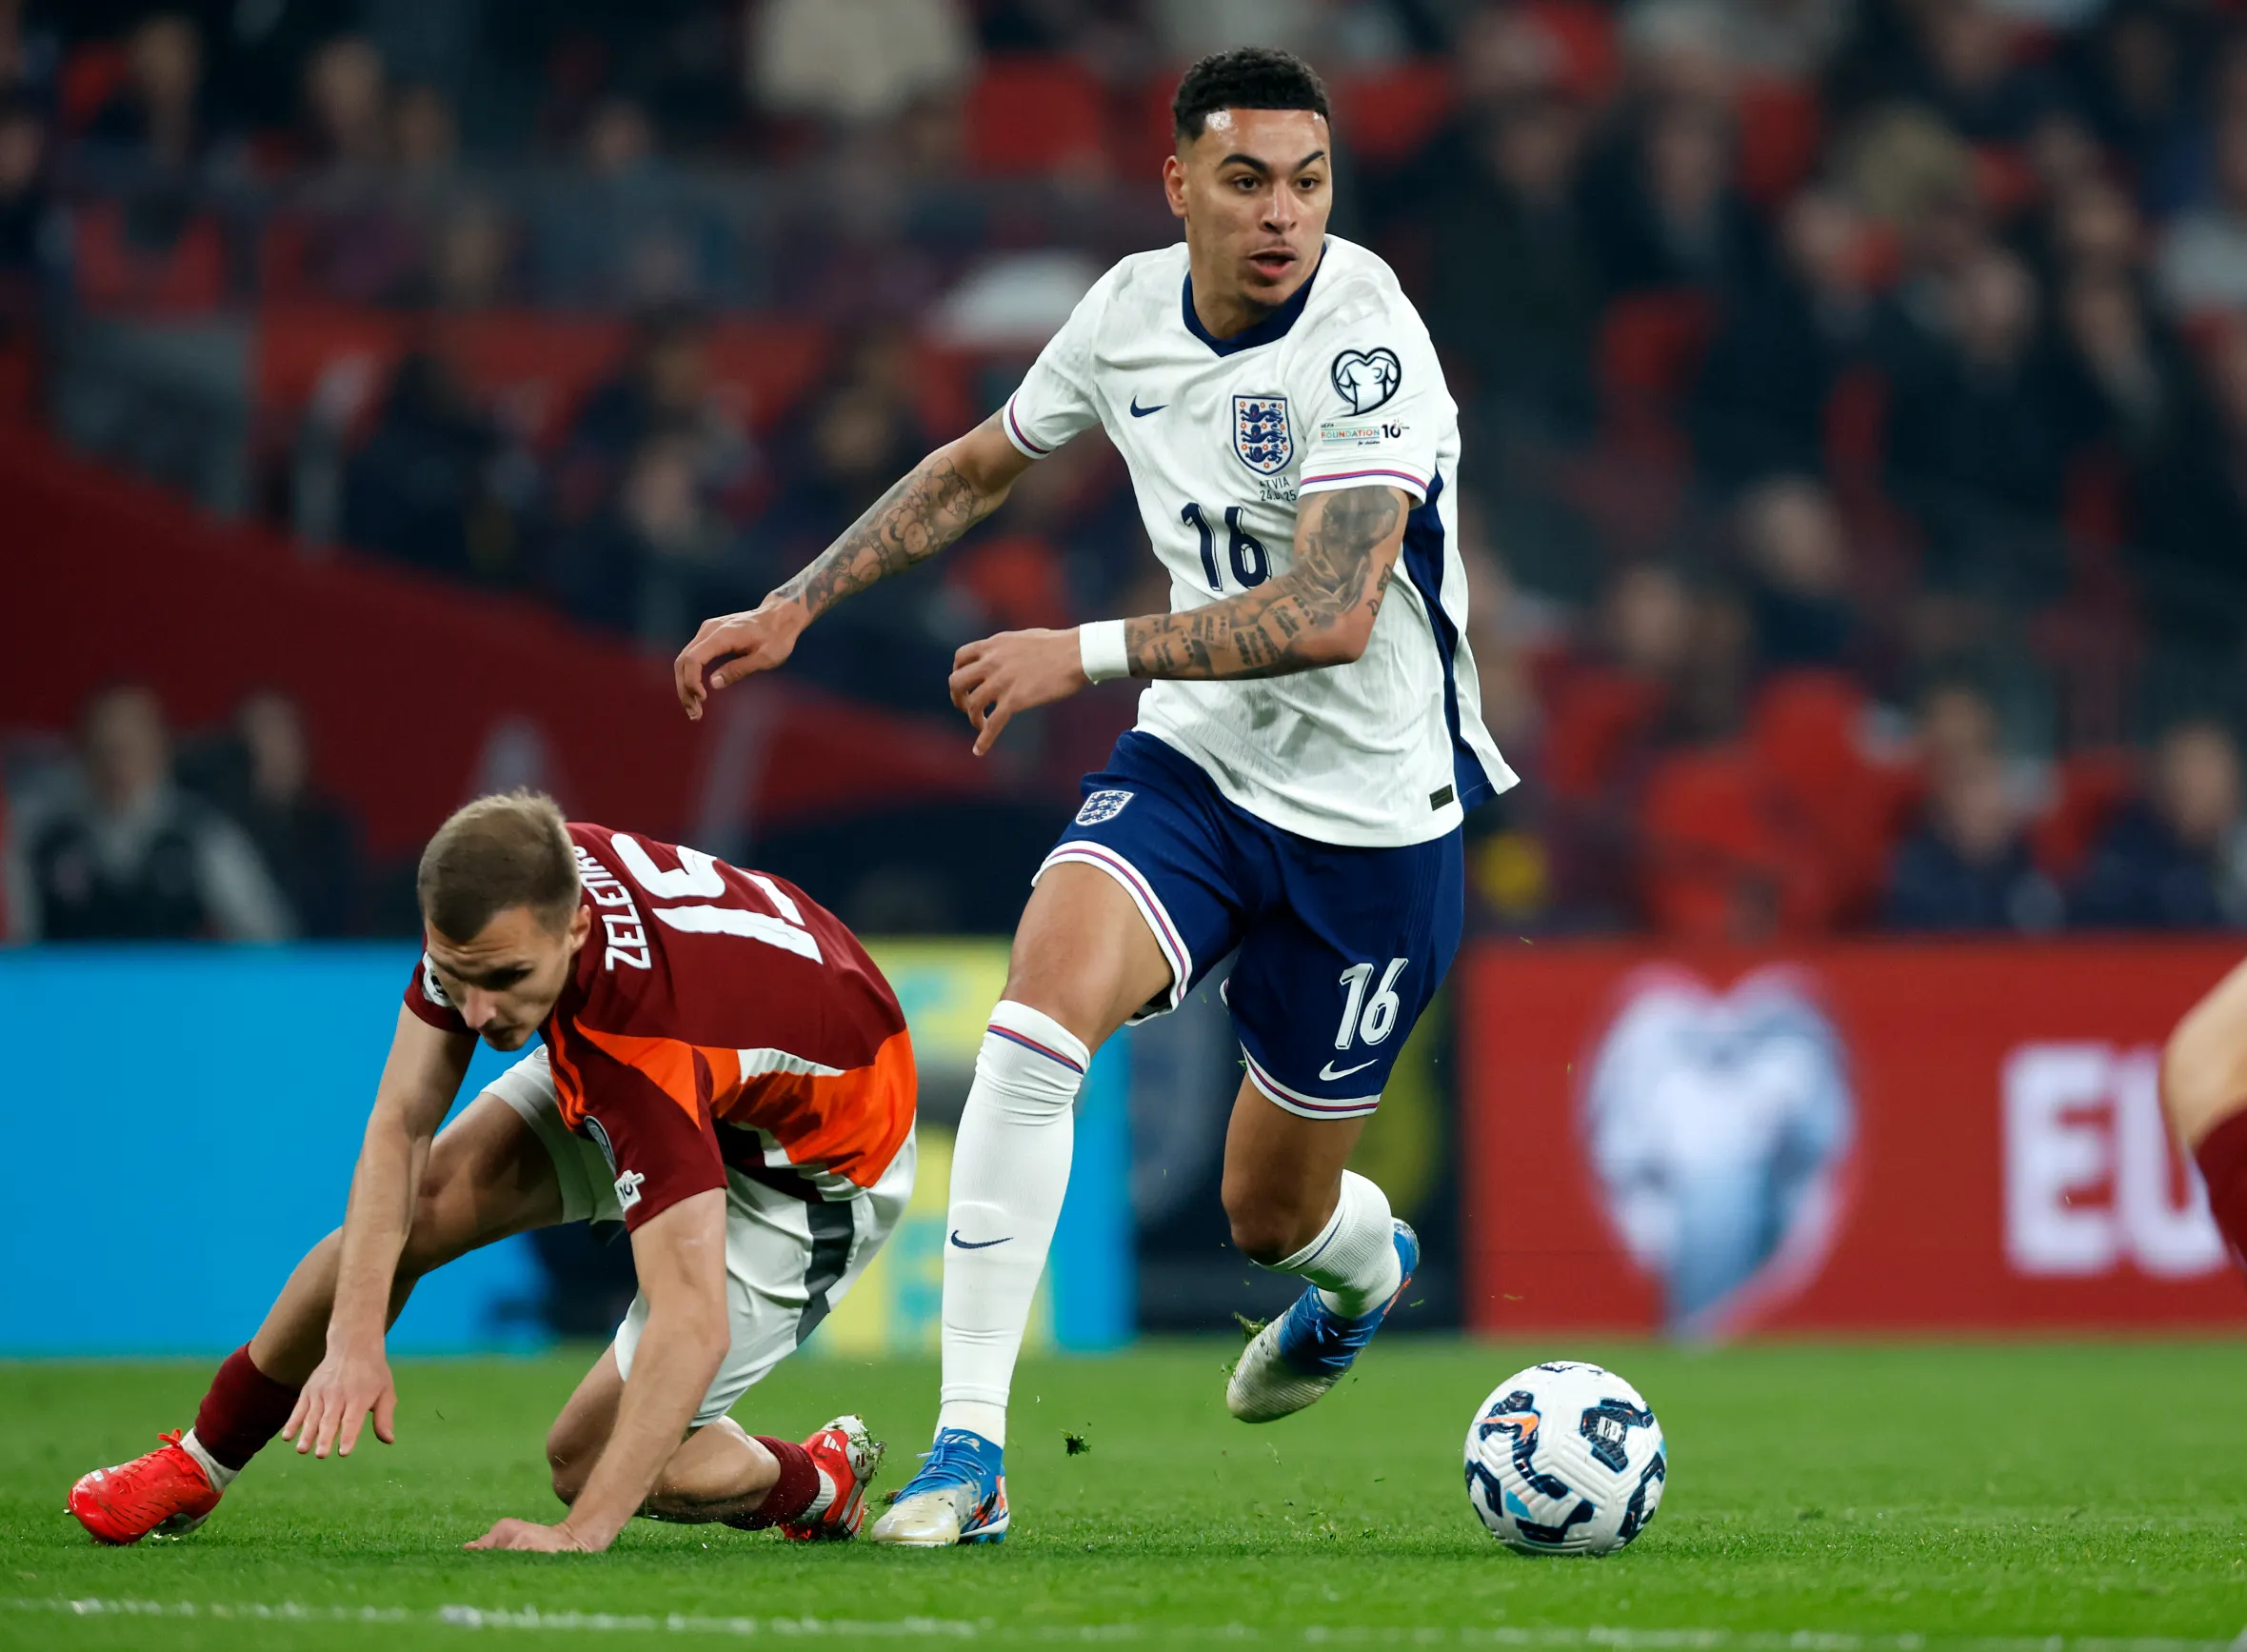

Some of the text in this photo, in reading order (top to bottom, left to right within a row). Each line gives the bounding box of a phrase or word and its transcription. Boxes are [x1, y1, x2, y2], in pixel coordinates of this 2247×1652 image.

[1321, 428, 1381, 439] FOUNDATION
[1382, 424, 1402, 439] 10
[1181, 502, 1272, 591] 16
[610, 833, 824, 965] 15
[1335, 958, 1409, 1049] 16
